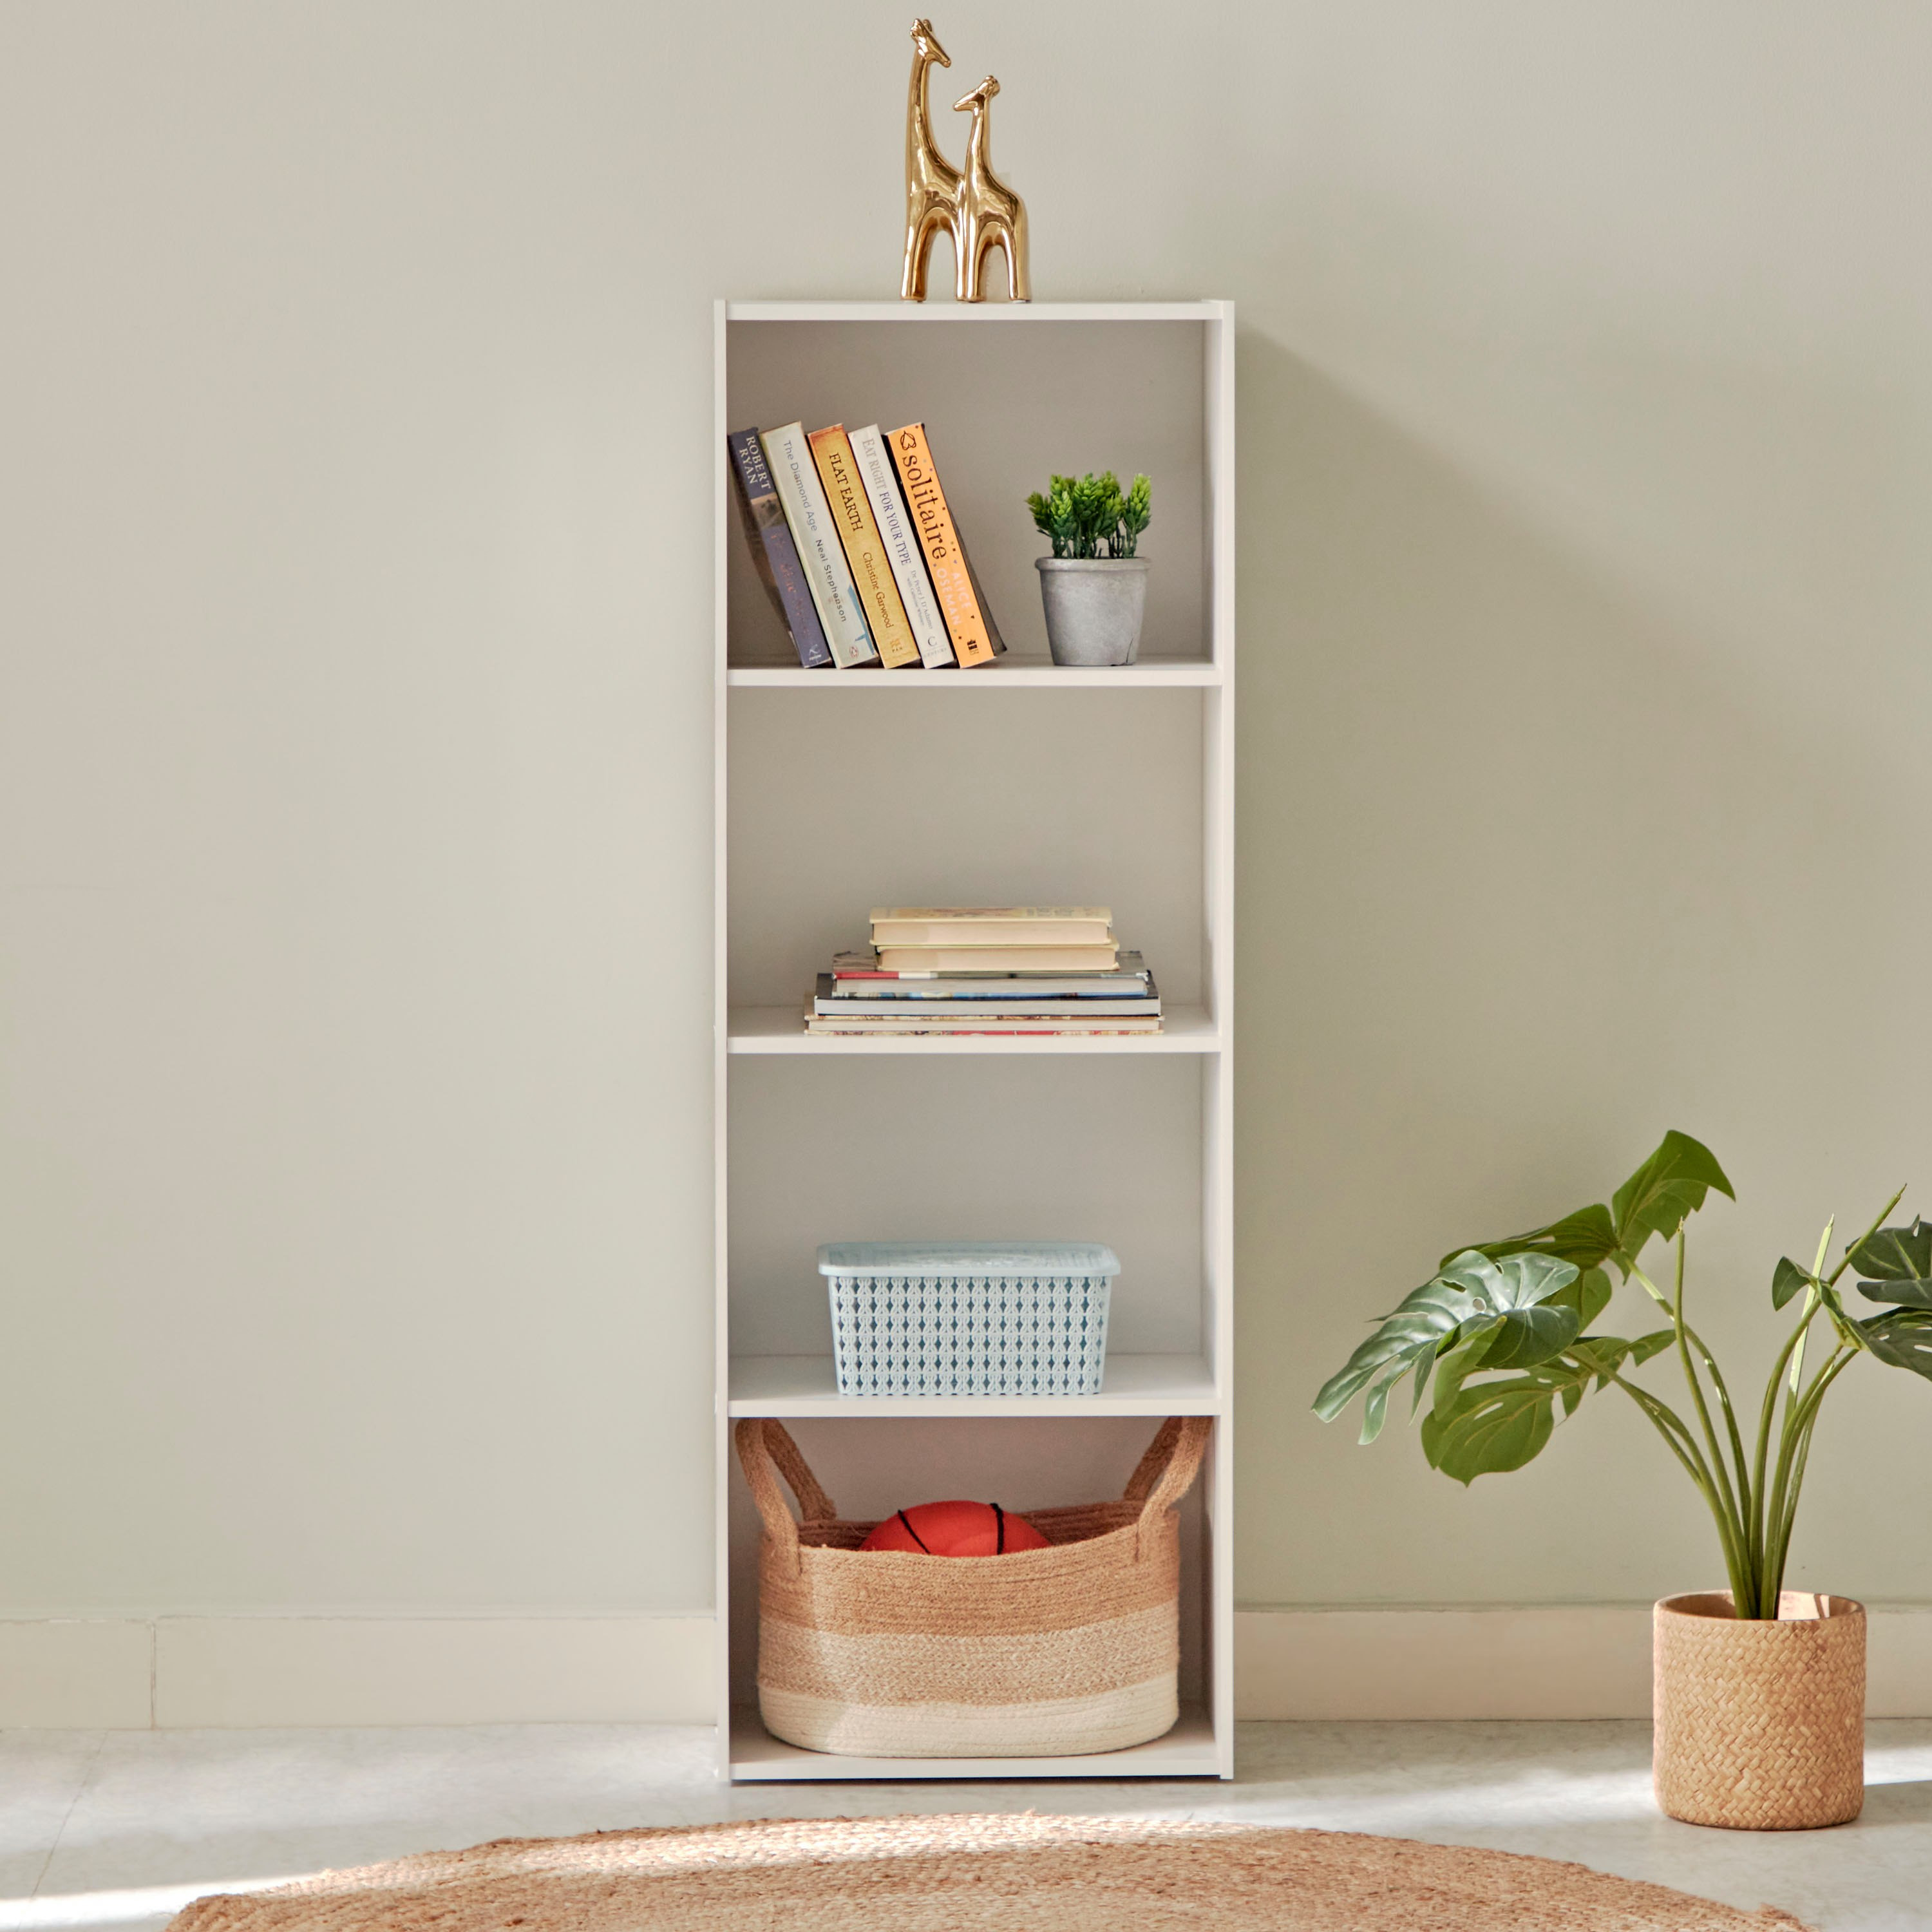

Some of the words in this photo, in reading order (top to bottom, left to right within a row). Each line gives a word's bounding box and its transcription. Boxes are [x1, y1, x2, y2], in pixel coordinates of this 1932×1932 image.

[739, 448, 757, 484] RYAN
[745, 436, 770, 489] ROBERT
[862, 438, 877, 458] EAT
[783, 440, 794, 460] The
[790, 462, 811, 508] Diamond
[805, 511, 818, 531] Age
[829, 452, 848, 485] FLAT
[840, 486, 863, 531] EARTH
[869, 459, 887, 489] RIGHT
[878, 491, 894, 512] FOR
[902, 454, 947, 560] solitaire
[886, 513, 903, 540] YOUR
[896, 541, 911, 565] TYPE
[815, 539, 828, 562] Neal
[823, 564, 846, 622] Stephenson
[862, 551, 879, 591] Christine
[875, 591, 894, 628] Garwood
[936, 567, 962, 625] OSEMAN
[951, 571, 971, 609] ALICE
